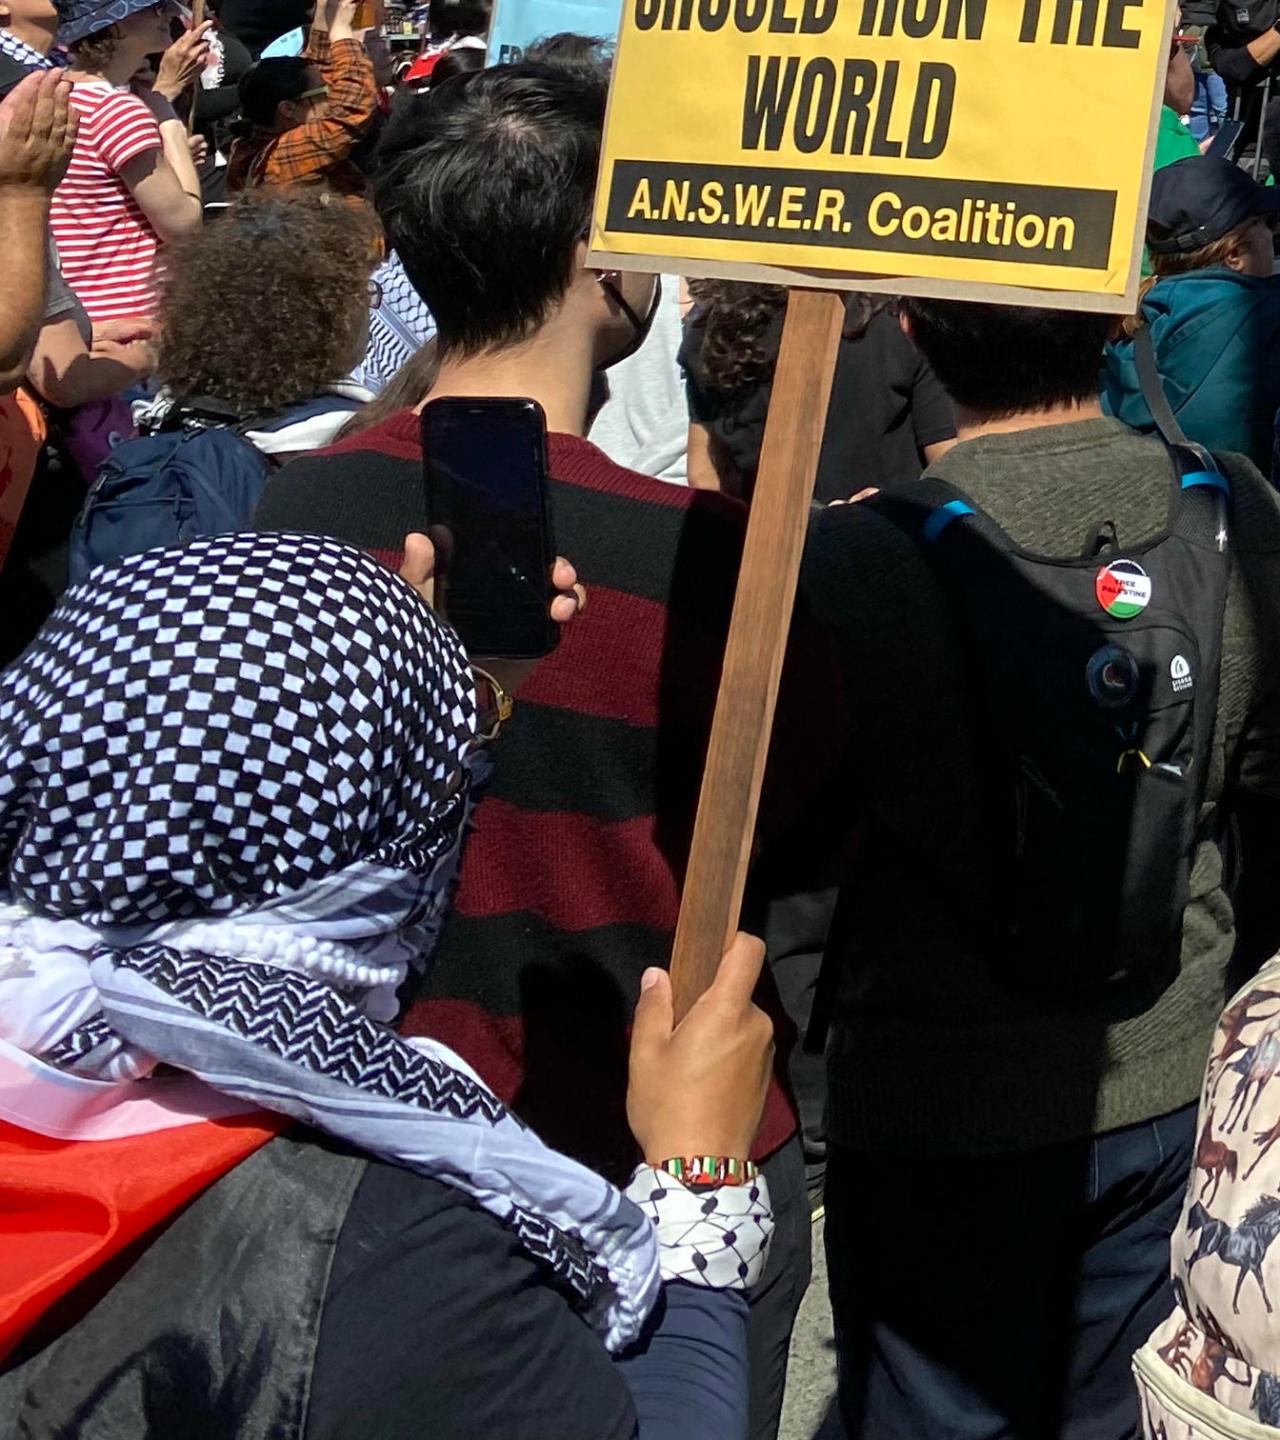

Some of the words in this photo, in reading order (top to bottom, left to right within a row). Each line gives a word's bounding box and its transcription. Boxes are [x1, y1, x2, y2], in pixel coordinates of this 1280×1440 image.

[741, 55, 957, 159] WORLD
[627, 178, 852, 233] A.N.S.W.E.R.
[867, 191, 1075, 251] Coalition
[1102, 585, 1146, 598] PALESTINE
